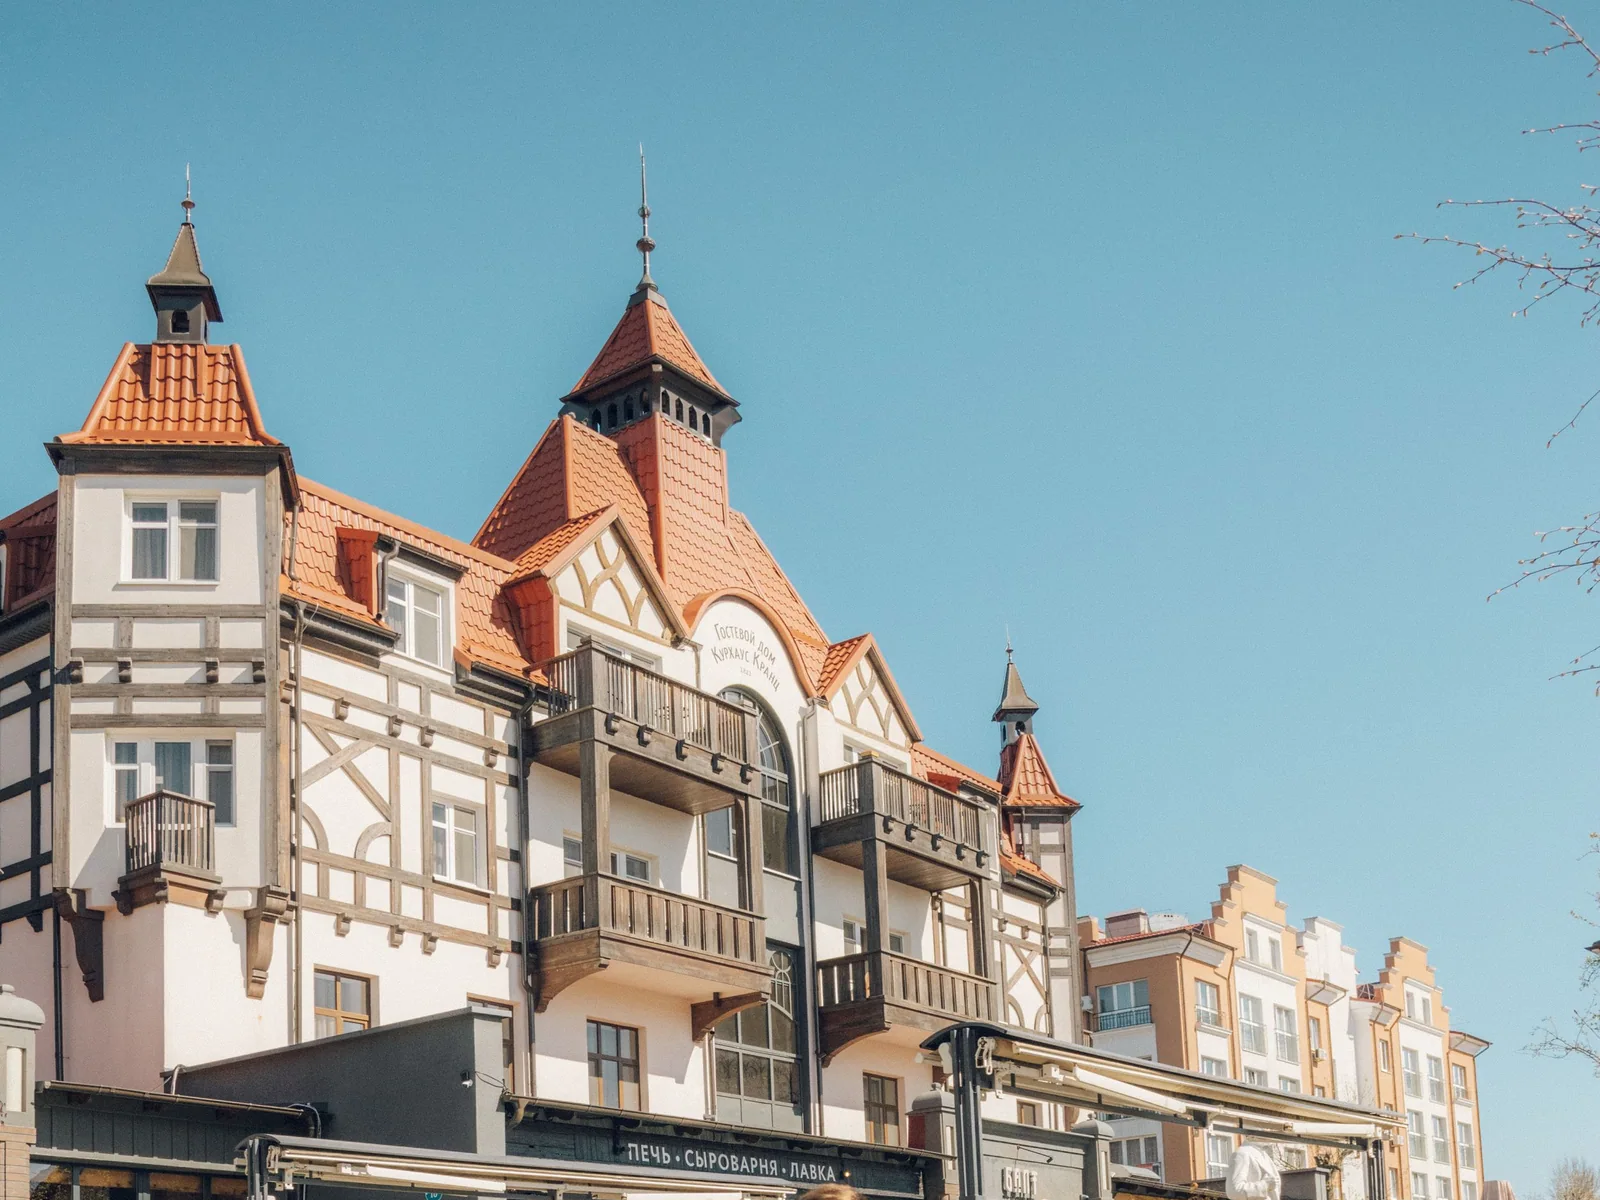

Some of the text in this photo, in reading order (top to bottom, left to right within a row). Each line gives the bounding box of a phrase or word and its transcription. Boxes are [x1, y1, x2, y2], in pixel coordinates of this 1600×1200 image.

[627, 1143, 836, 1182] ПЕЧЬ СЫРОВАРНЯ ЛАВКА
